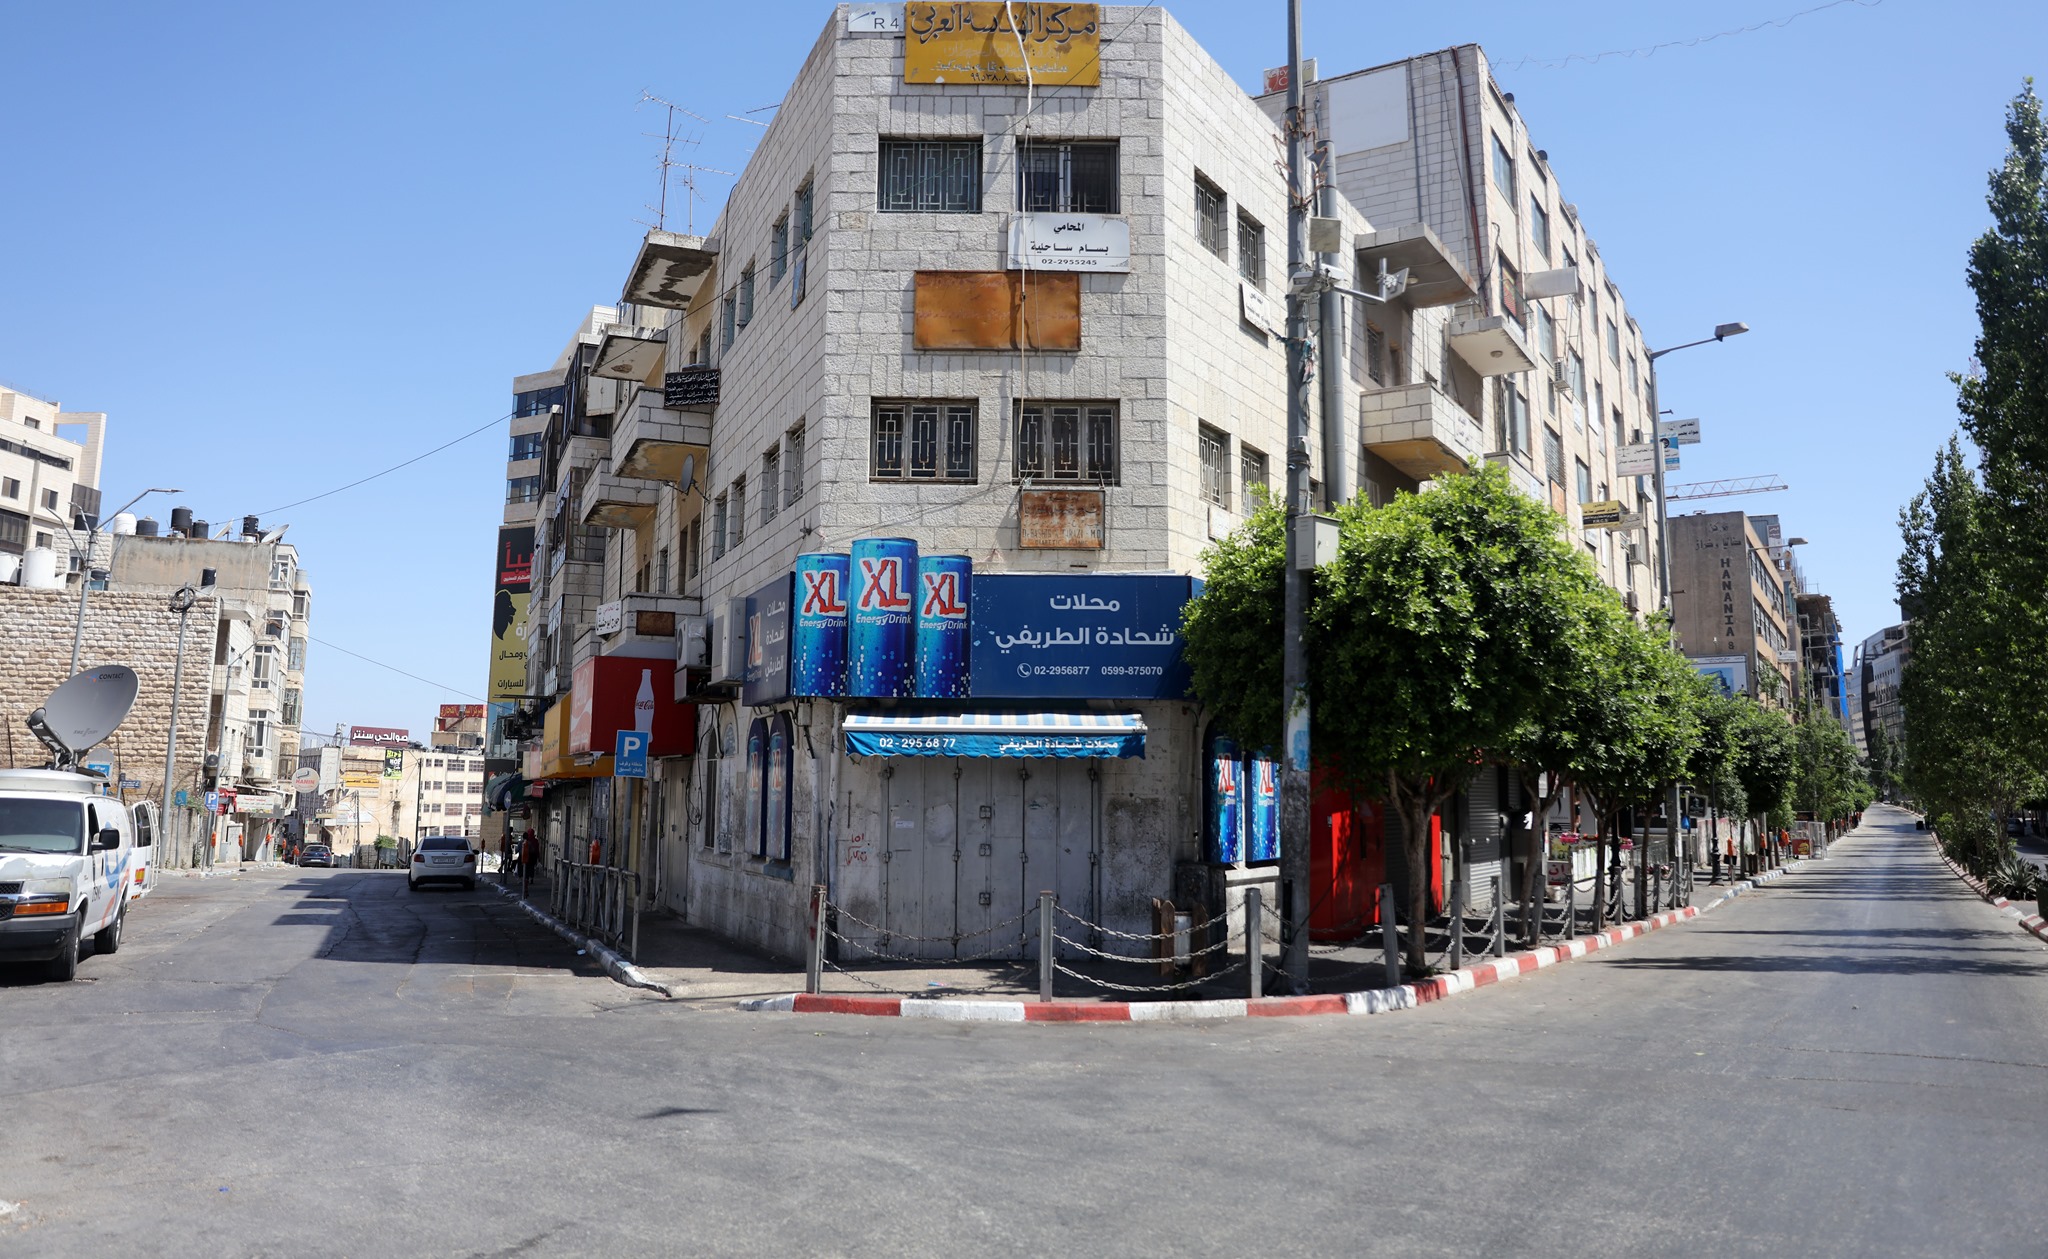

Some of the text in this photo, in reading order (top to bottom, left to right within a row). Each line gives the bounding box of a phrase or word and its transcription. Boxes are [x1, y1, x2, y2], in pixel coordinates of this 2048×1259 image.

[874, 17, 899, 29] R 4
[910, 4, 964, 45] العربي
[1033, 5, 1097, 44] مركز
[1053, 222, 1085, 234] المحامي
[1078, 242, 1109, 255] بسام
[1041, 258, 1098, 266] 02-2955245
[803, 571, 846, 614] XL
[859, 558, 911, 609] XL
[923, 573, 966, 615] XL
[1049, 593, 1120, 612] محلات
[1720, 557, 1735, 638] HANANIA
[766, 600, 786, 617] محلات
[765, 621, 785, 645] شحادة
[995, 623, 1174, 653] شحادة الطريفي
[764, 655, 785, 682] الطريفي
[1034, 665, 1163, 676] 02-2956877 0599-875070
[497, 679, 524, 692] للسيارات
[353, 729, 408, 745] صوالحي سنتر
[623, 736, 641, 758] P
[879, 737, 893, 748] 02
[901, 737, 923, 748] 295
[925, 737, 940, 748] 68
[943, 737, 956, 748] 77
[999, 737, 1118, 753] محلات شحادة الطريفي
[1217, 753, 1235, 795] XL
[1258, 757, 1274, 796] XL
[207, 793, 217, 804] P
